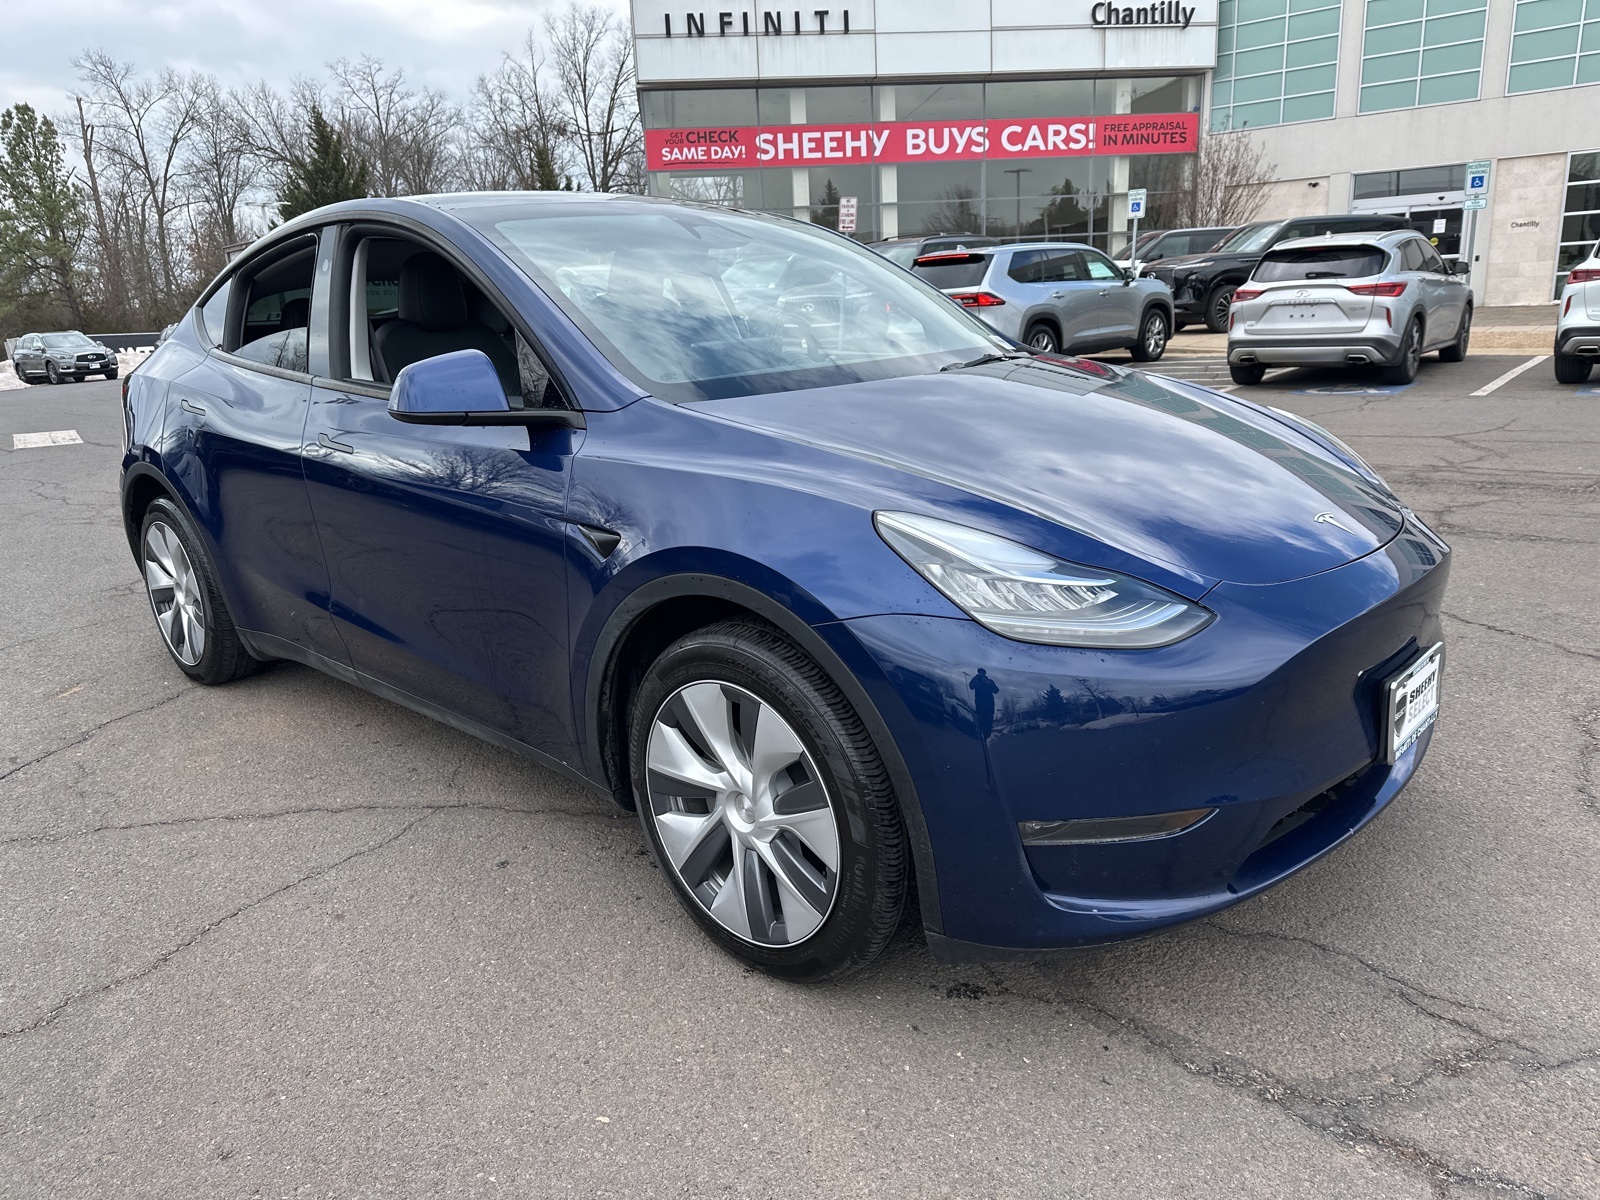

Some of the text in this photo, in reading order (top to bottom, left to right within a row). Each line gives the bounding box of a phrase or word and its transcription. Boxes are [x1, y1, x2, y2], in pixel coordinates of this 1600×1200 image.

[665, 10, 849, 37] INFINITI
[1091, 0, 1196, 30] Chantilly
[685, 130, 739, 144] CHECK
[1104, 121, 1188, 132] FREE APPRAISAL
[755, 122, 1097, 161] SHEEHY BUYS CARS!
[1103, 131, 1187, 146] IN MINUTES
[661, 145, 746, 161] SAME DAY!
[1511, 220, 1540, 228] Chantilly
[1409, 669, 1437, 704] SHEEHY
[1407, 685, 1435, 723] SELECT
